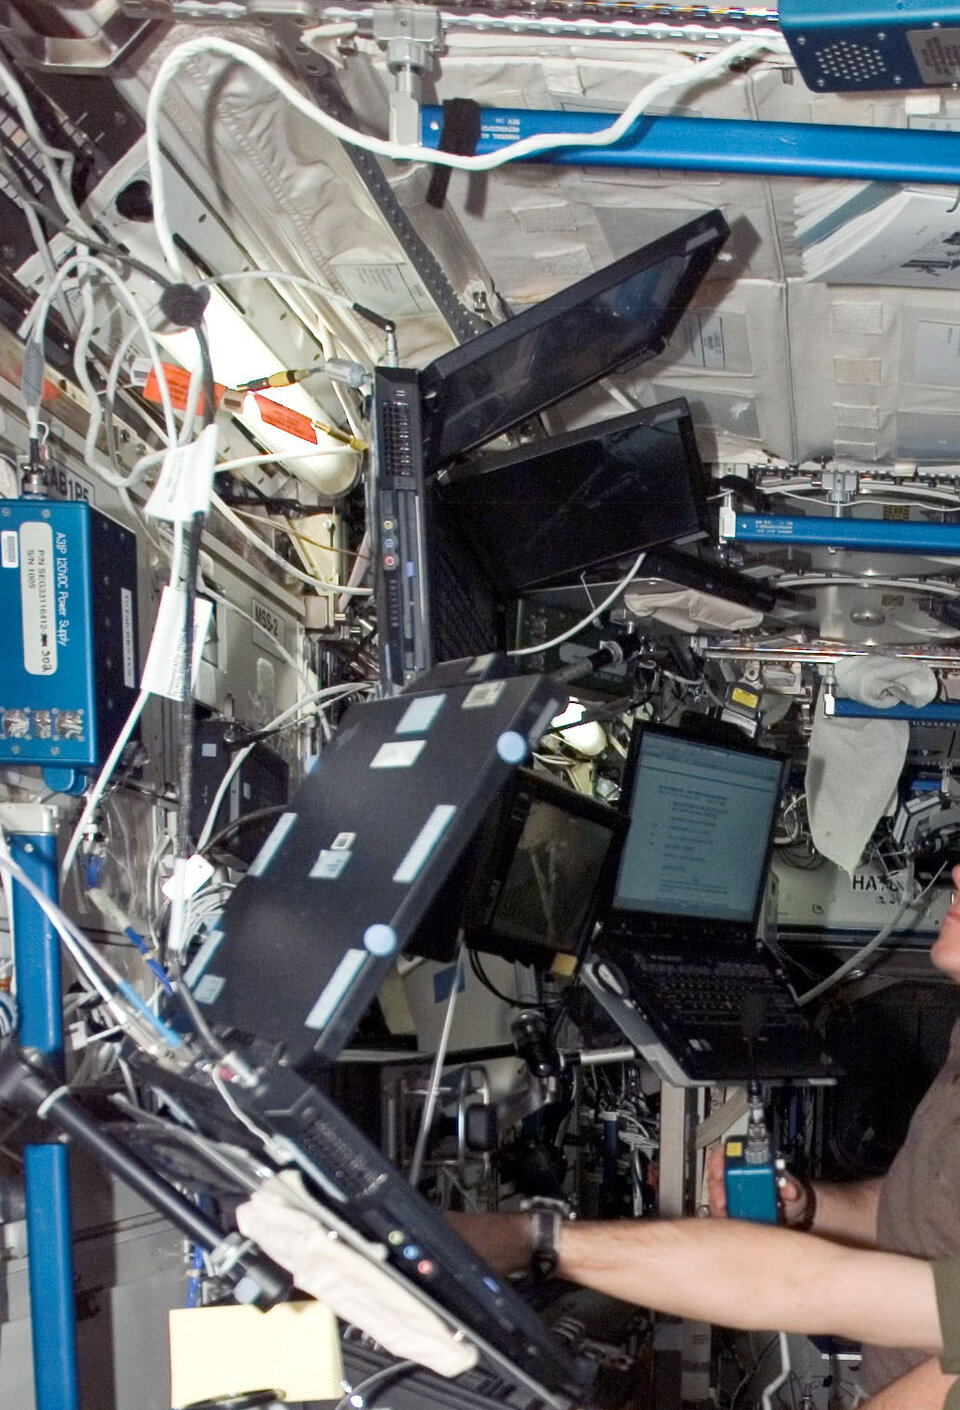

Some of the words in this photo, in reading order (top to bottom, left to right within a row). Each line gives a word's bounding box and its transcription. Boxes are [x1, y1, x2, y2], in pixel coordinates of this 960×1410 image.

[55, 532, 67, 554] A31P
[56, 557, 69, 589] 120VDC
[58, 591, 69, 616] Power
[57, 619, 70, 647] Supply
[254, 605, 281, 637] MSS-2
